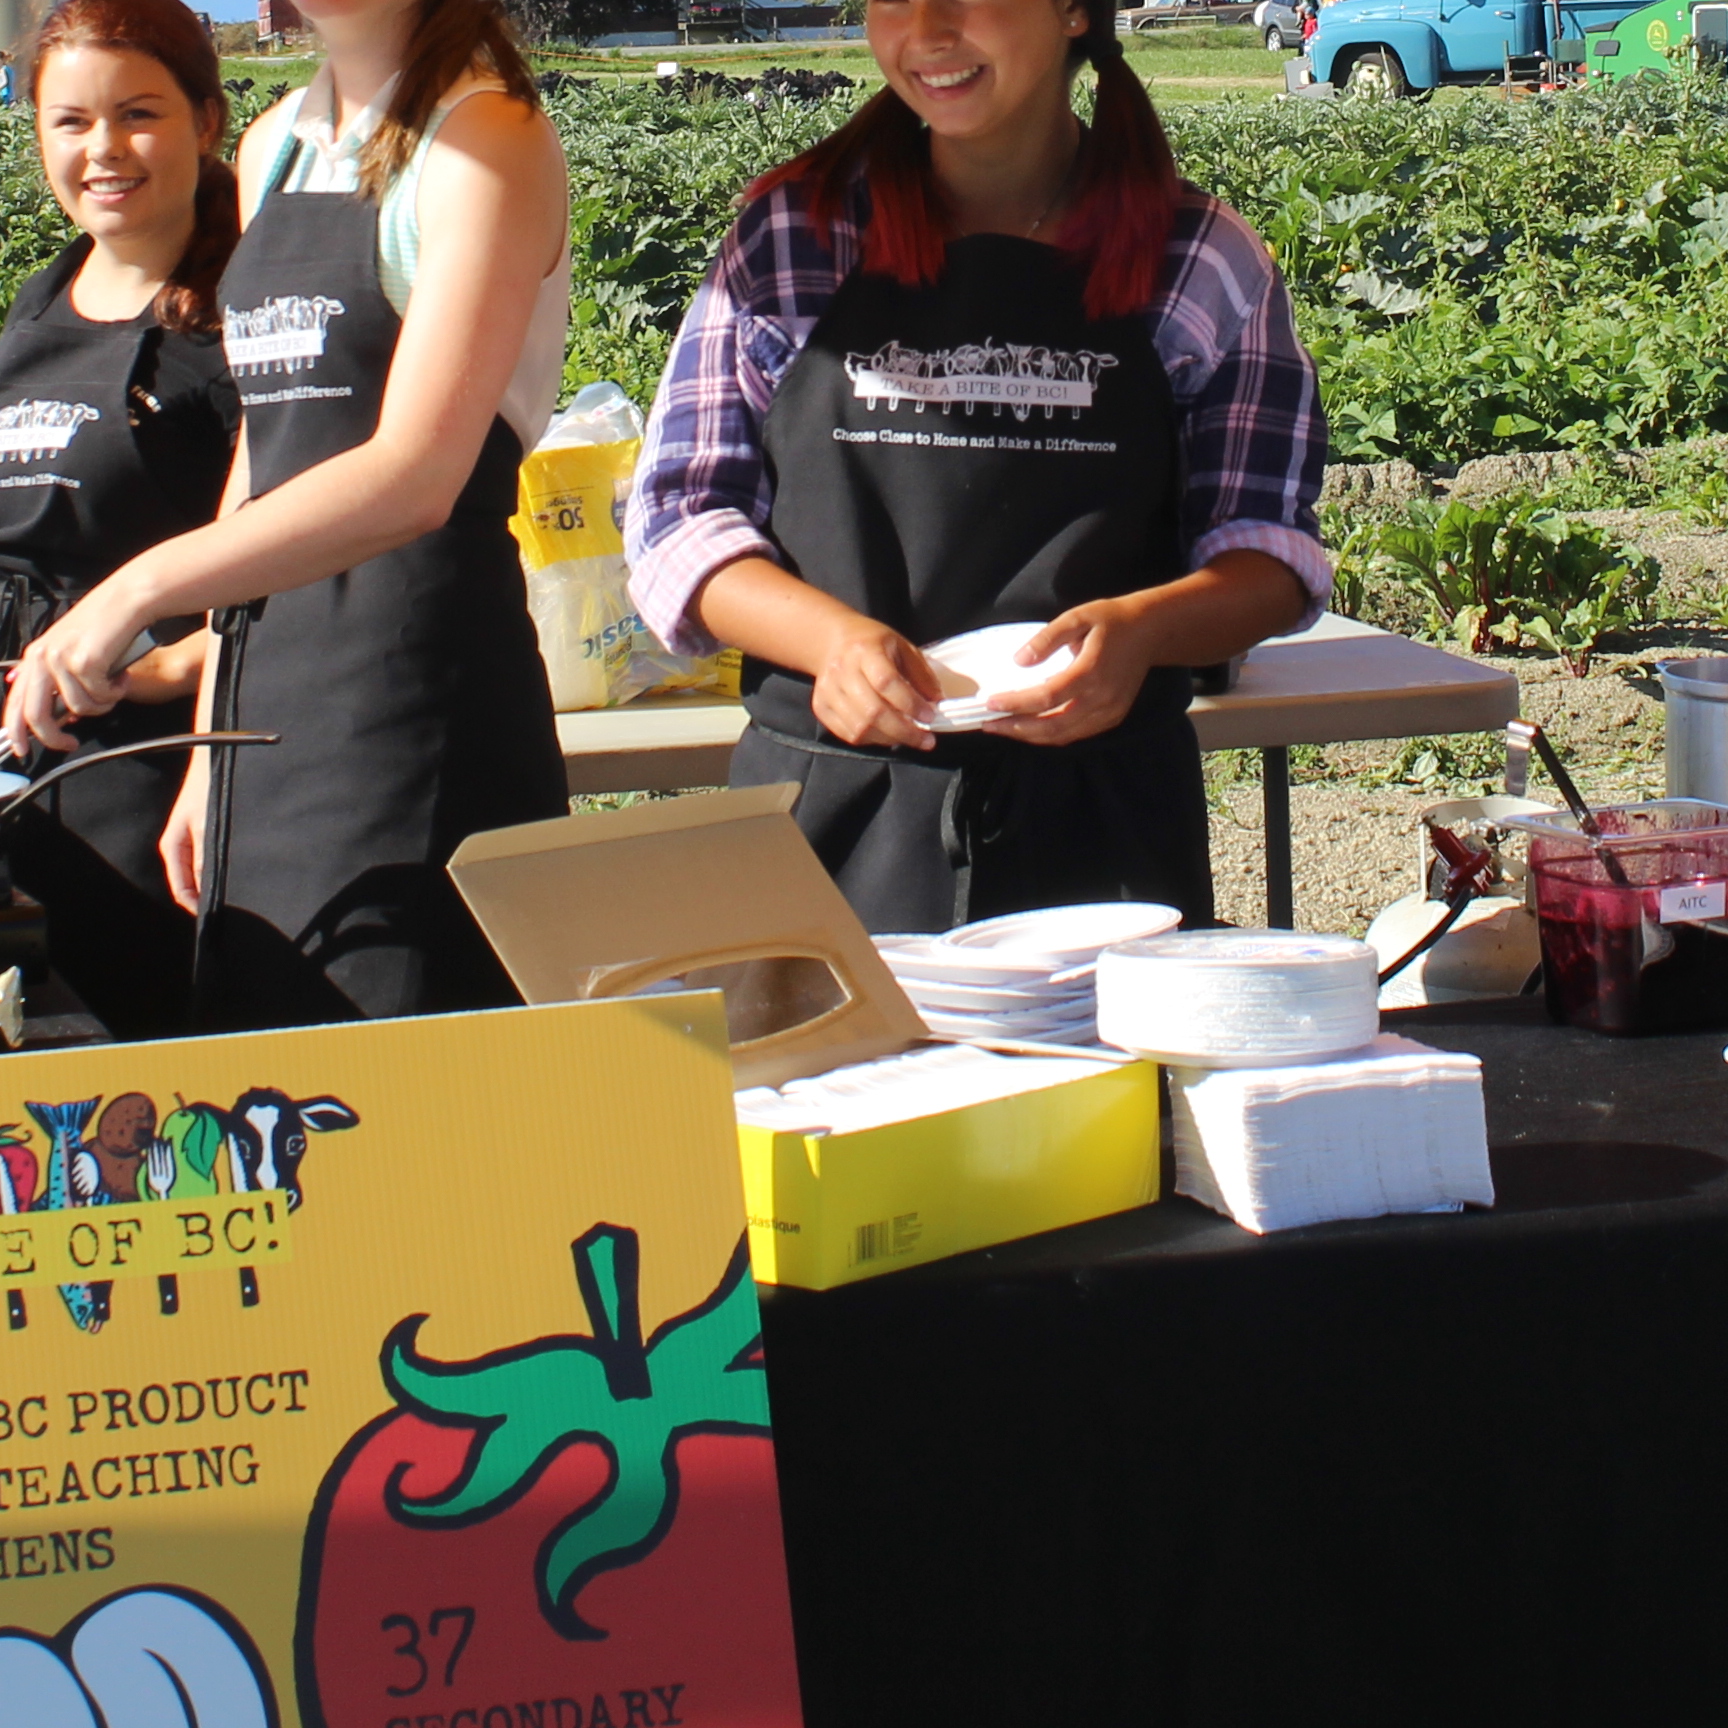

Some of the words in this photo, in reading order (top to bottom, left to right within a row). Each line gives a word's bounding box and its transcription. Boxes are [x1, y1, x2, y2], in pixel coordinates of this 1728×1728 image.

[880, 376, 934, 396] TAKE
[939, 381, 950, 396] A
[956, 380, 1002, 396] BITE
[1006, 381, 1032, 397] OF
[1037, 382, 1069, 399] BC!
[832, 427, 877, 443] Choose
[879, 429, 914, 445] Close
[916, 430, 931, 446] to
[933, 431, 968, 447] Home
[970, 433, 995, 449] and
[998, 435, 1031, 450] Make
[1034, 439, 1042, 450] a
[1045, 437, 1117, 452] Difference
[1678, 893, 1709, 911] AITC
[68, 1217, 143, 1268] OF
[178, 1199, 280, 1258] BC!
[747, 1215, 801, 1235] plastique
[68, 1369, 310, 1434] PRODUCT
[380, 1605, 476, 1698] 37
[384, 1683, 686, 1728] ONDARY
